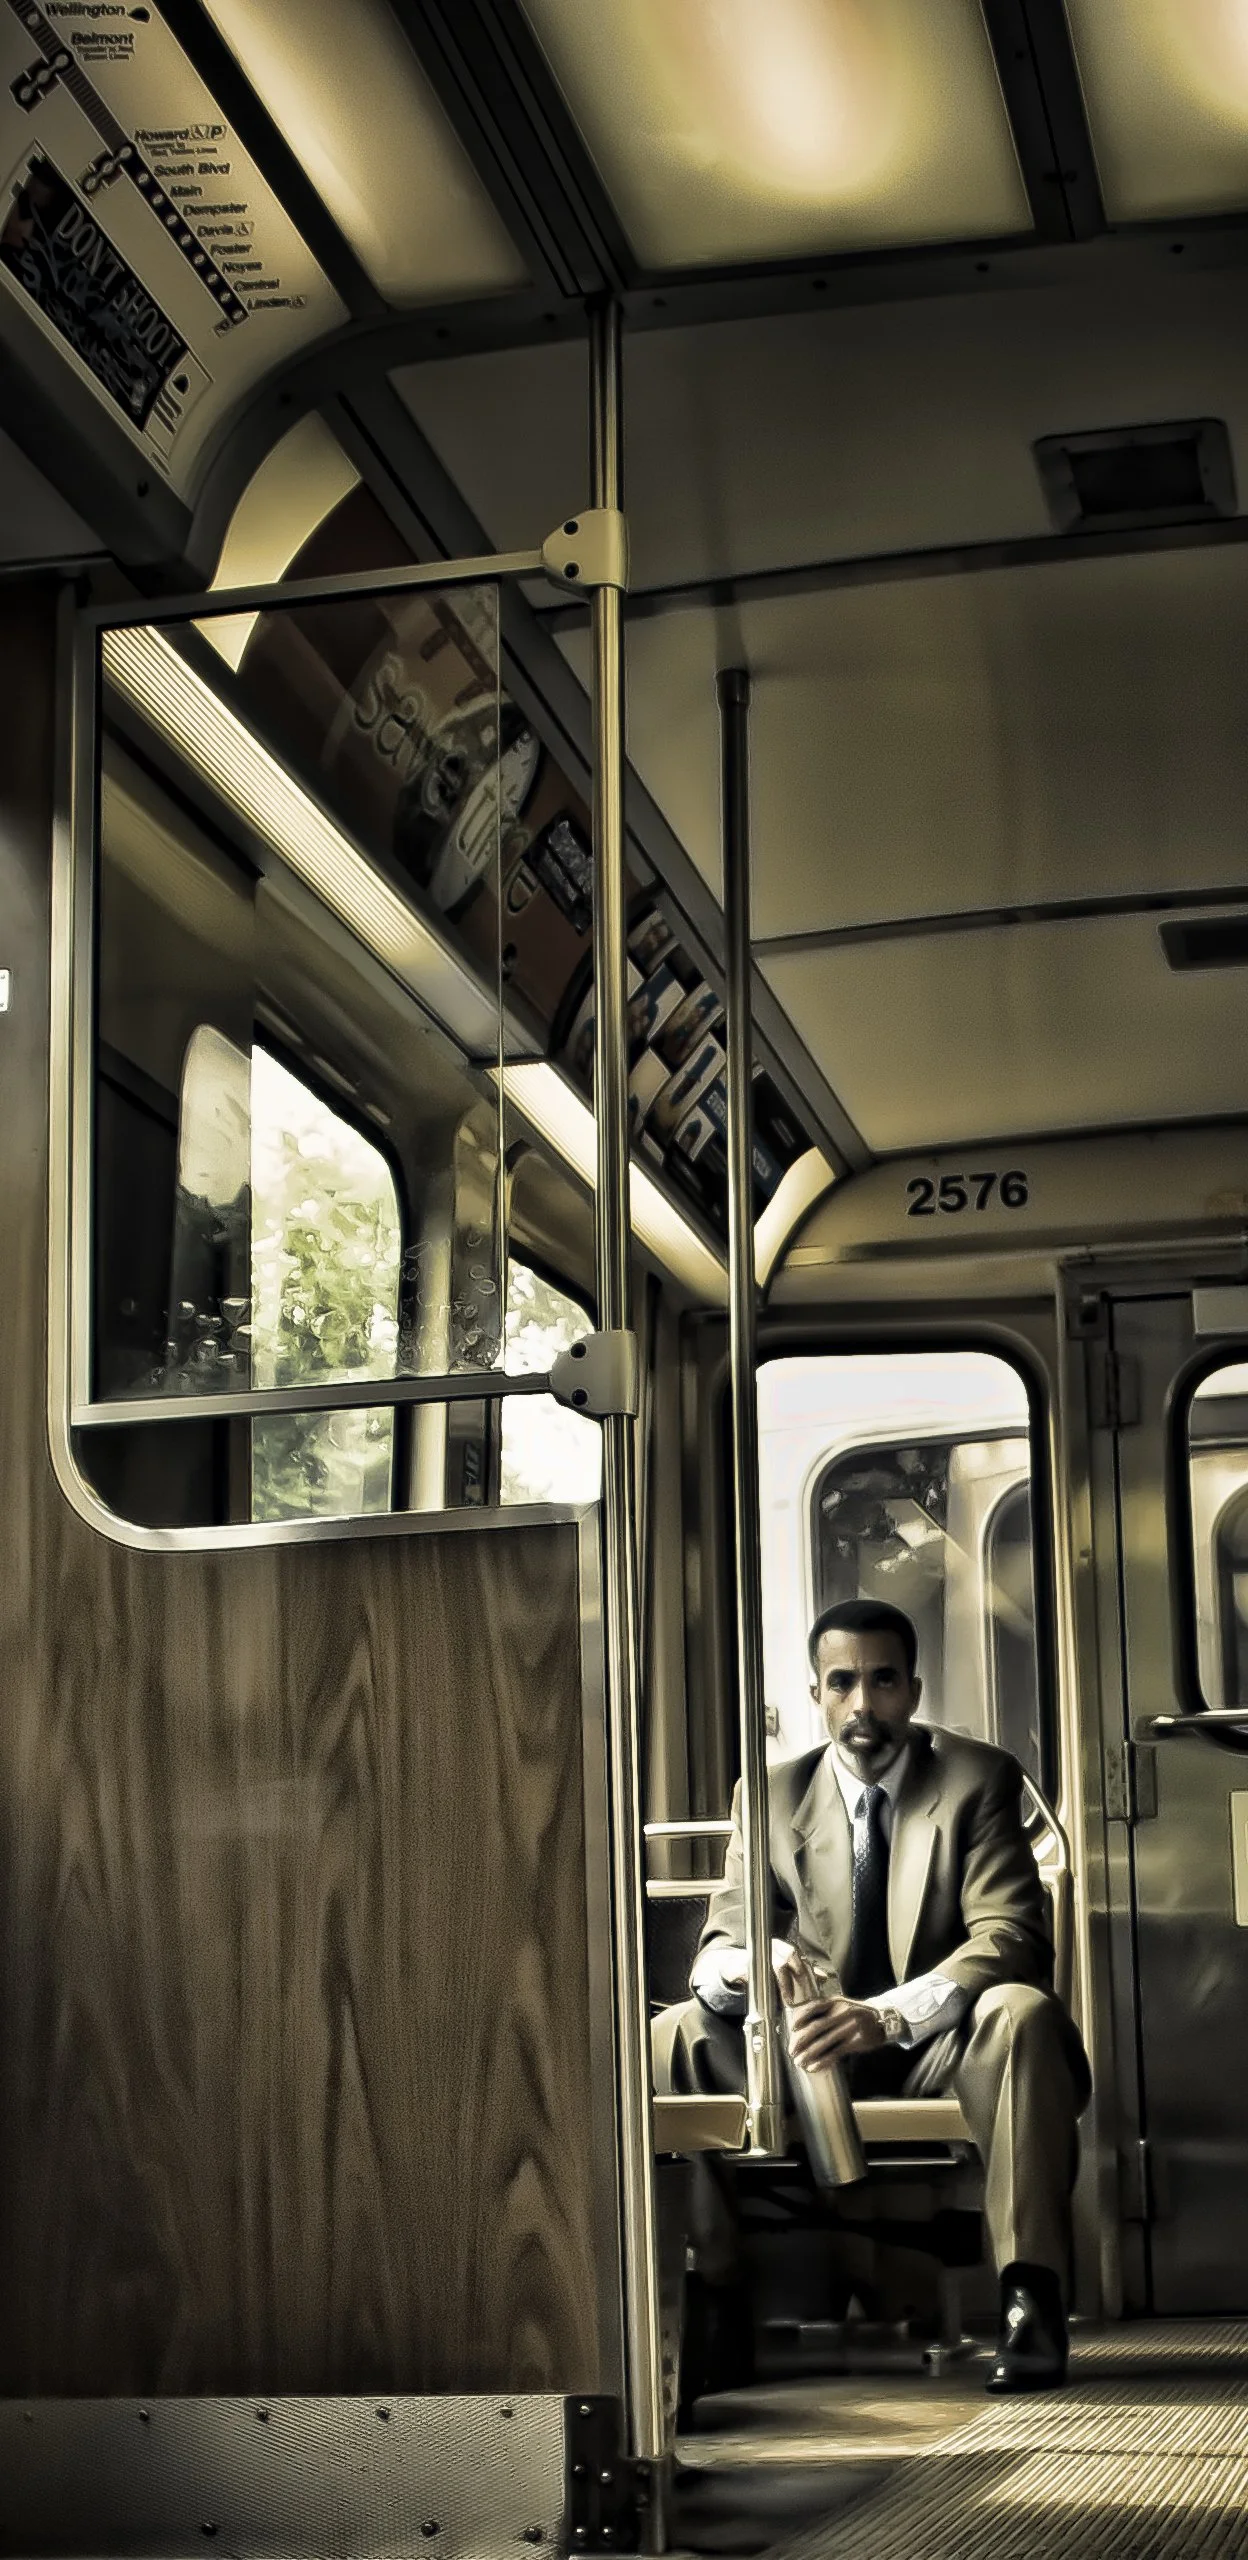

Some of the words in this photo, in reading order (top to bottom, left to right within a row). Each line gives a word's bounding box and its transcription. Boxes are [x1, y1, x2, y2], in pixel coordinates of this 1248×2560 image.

[46, 2, 125, 18] Wellington
[72, 32, 134, 44] Belmont
[134, 128, 189, 141] Howard
[154, 163, 194, 176] South
[198, 162, 230, 174] Blvd
[170, 185, 202, 197] Main
[113, 279, 181, 367] SHOOT
[907, 1170, 1028, 1216] 2576
